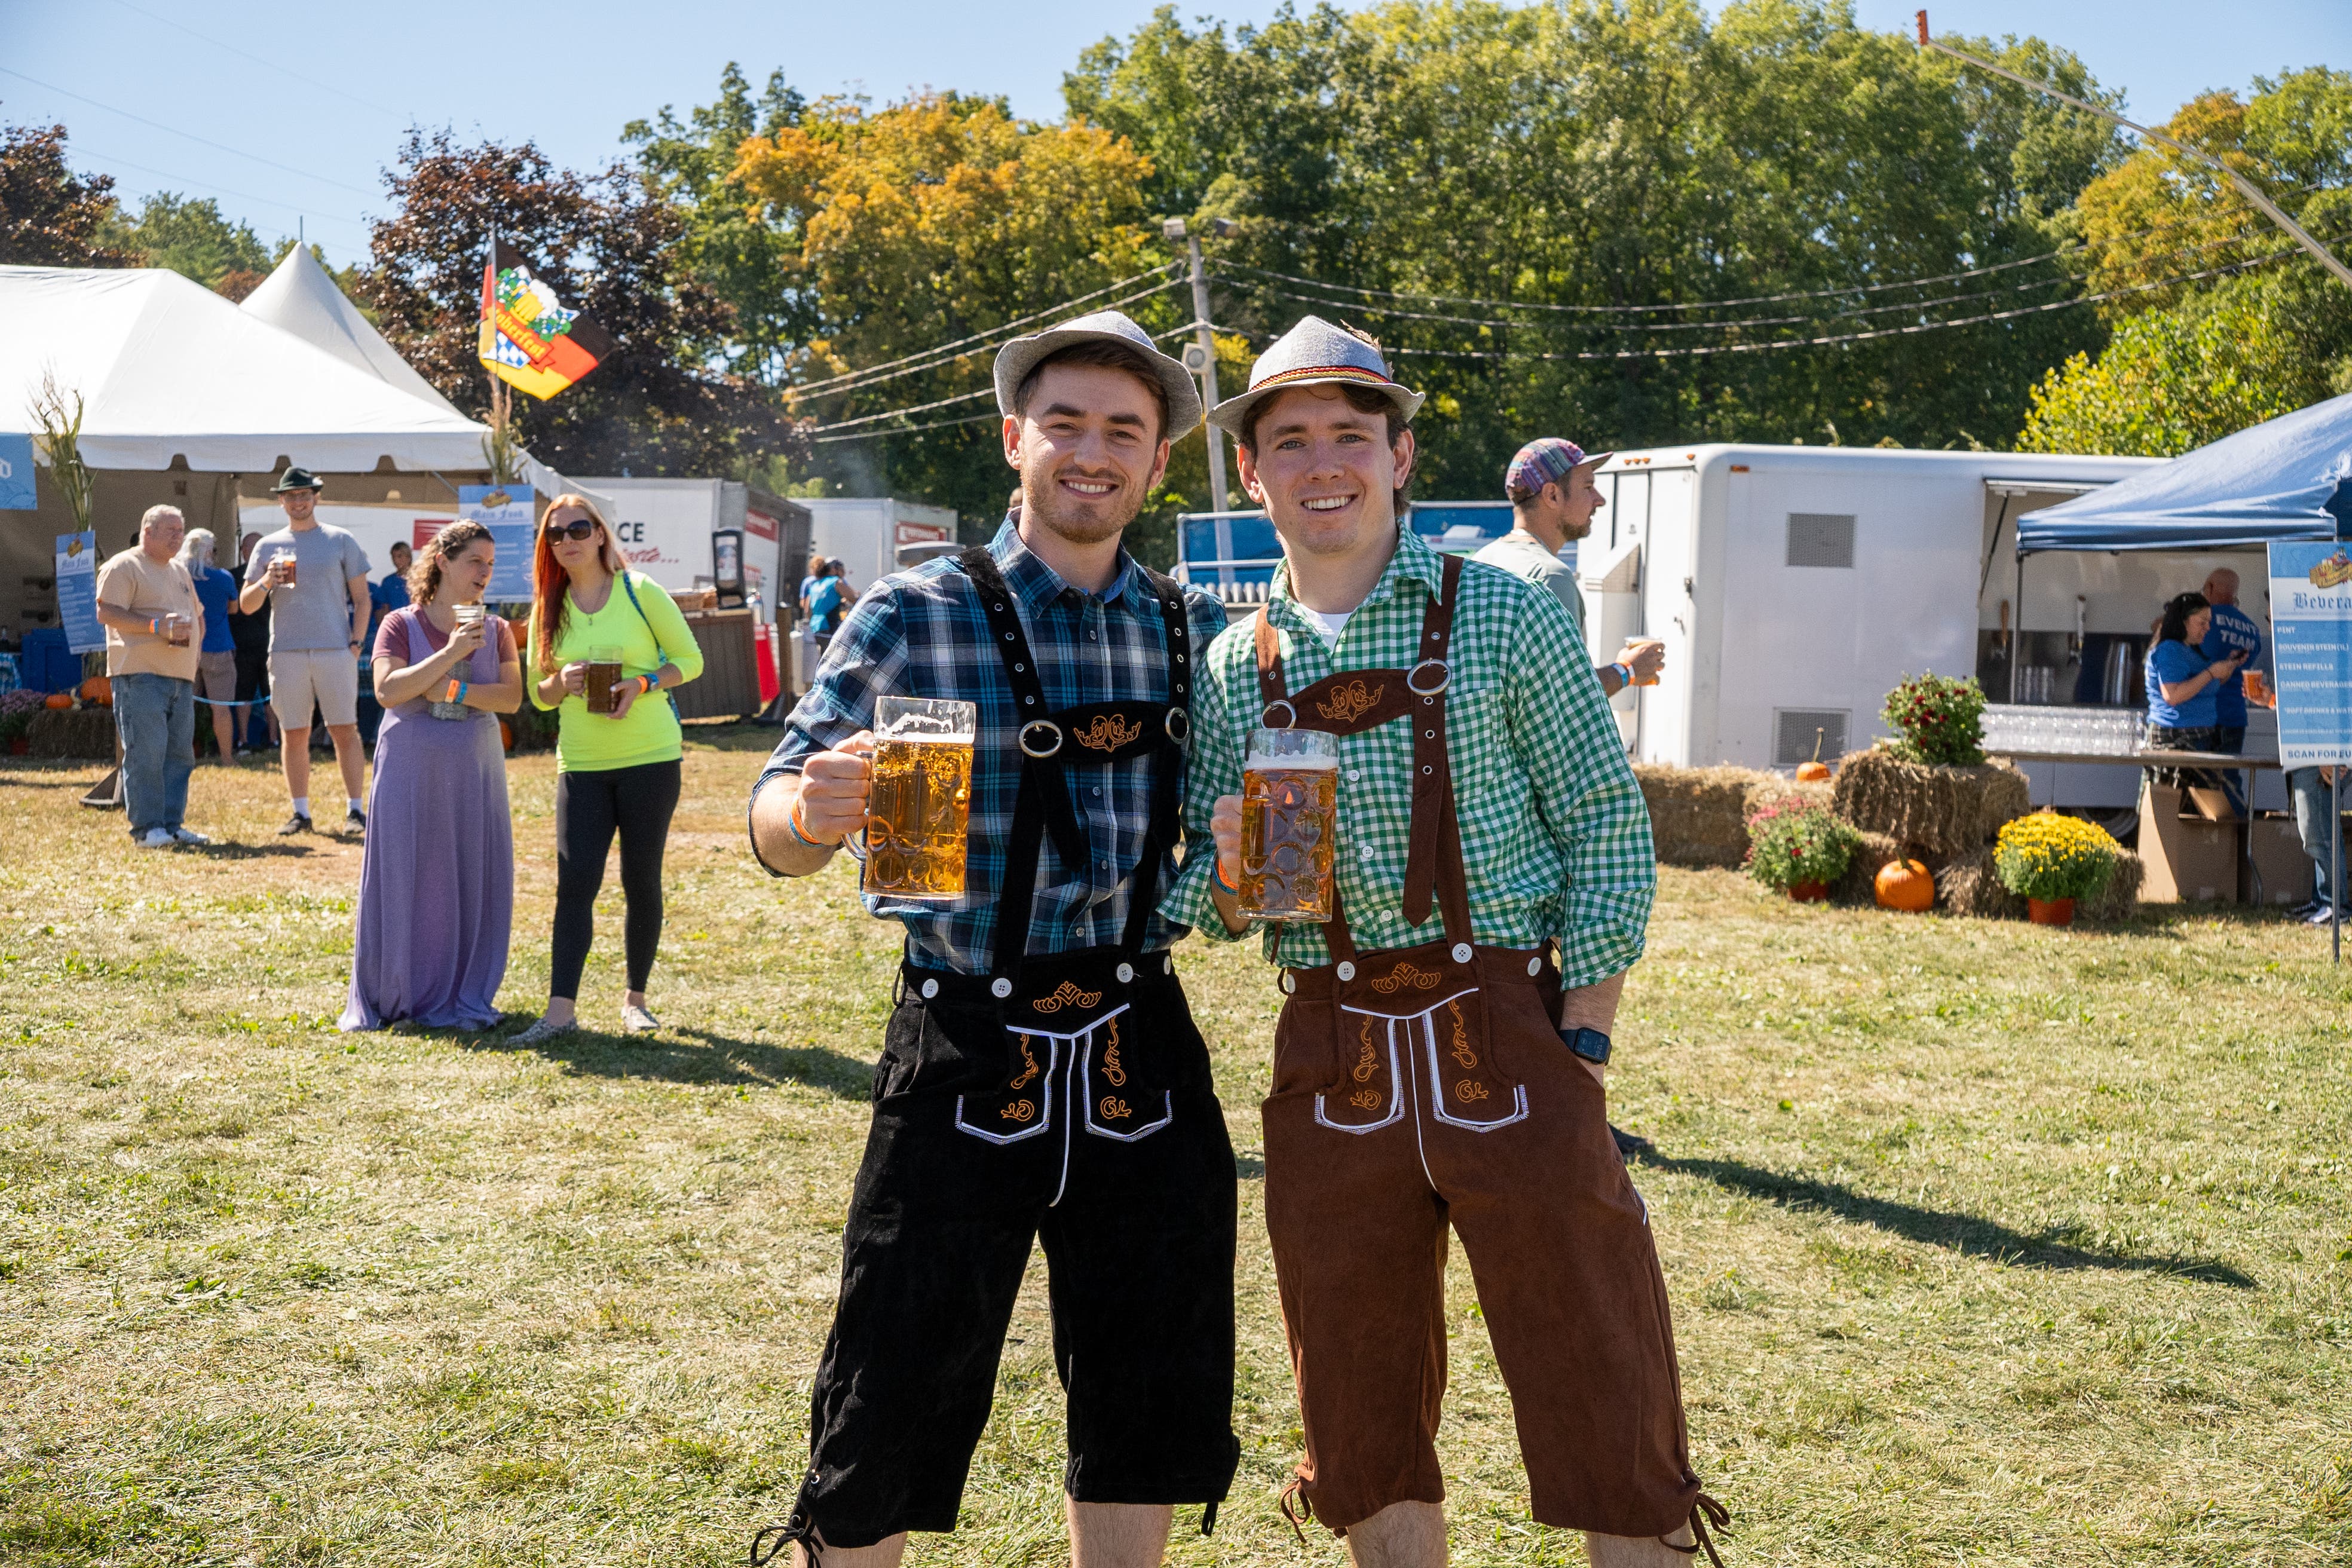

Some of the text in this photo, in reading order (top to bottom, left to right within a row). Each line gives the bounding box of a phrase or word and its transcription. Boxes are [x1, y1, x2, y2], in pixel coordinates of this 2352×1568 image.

[2216, 613, 2256, 636] EVENT
[2220, 629, 2255, 651] TEAM
[2287, 750, 2315, 759] SCAN
[2317, 750, 2337, 758] FOR
